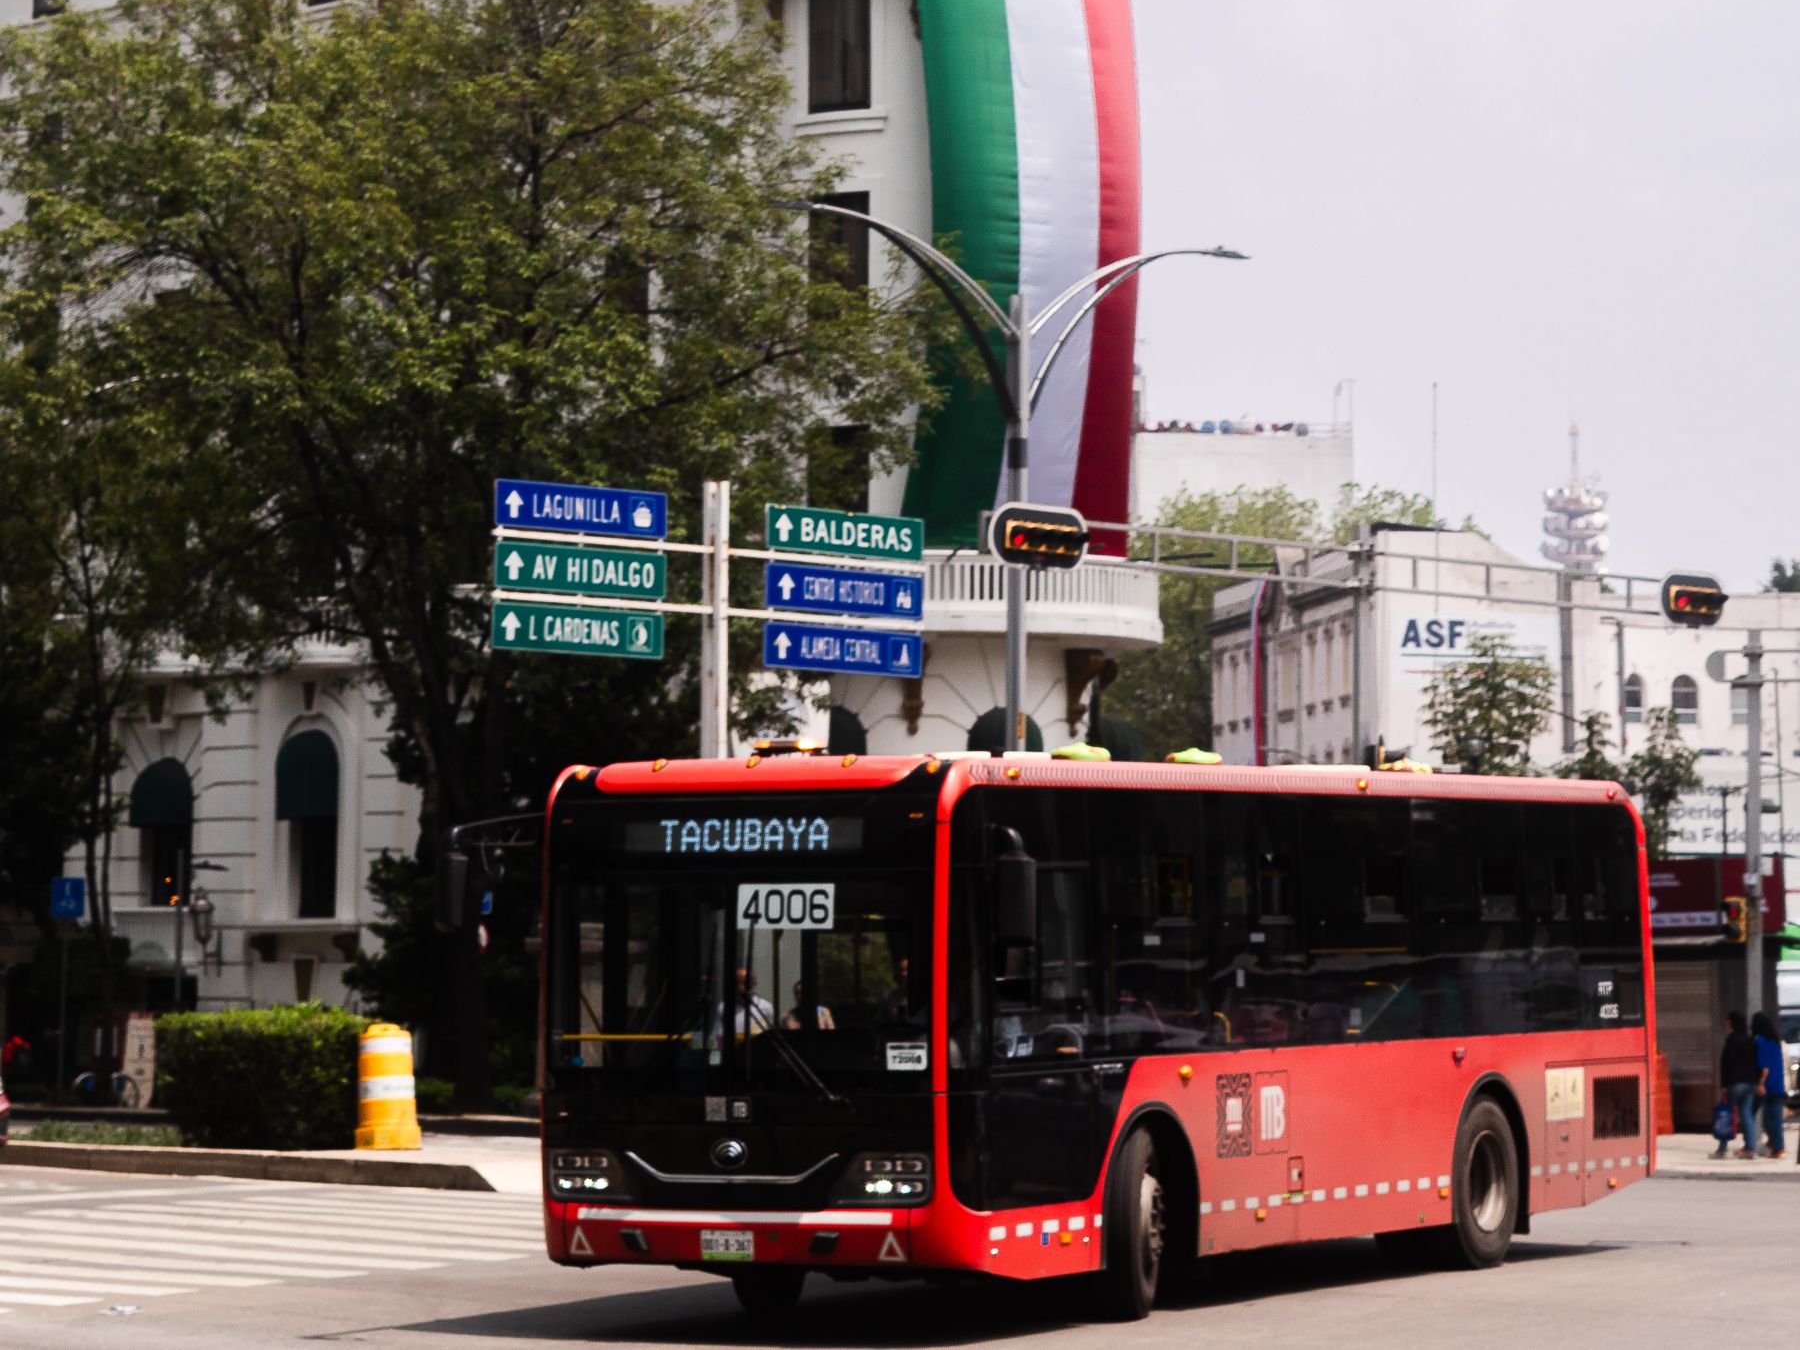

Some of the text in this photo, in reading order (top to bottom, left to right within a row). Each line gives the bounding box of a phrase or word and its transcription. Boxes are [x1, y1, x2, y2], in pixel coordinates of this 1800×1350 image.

[532, 493, 621, 525] LAGUNILLA
[800, 517, 913, 552] BALDERAS
[532, 554, 655, 589] AV HIDALGO
[803, 576, 836, 602] CENTRO
[529, 614, 620, 647] L CARDENAS
[1401, 619, 1465, 649] ASF
[801, 635, 882, 665] ALAMEDA CENTRAL
[659, 817, 831, 853] TACUBAYA
[742, 888, 830, 925] 4006
